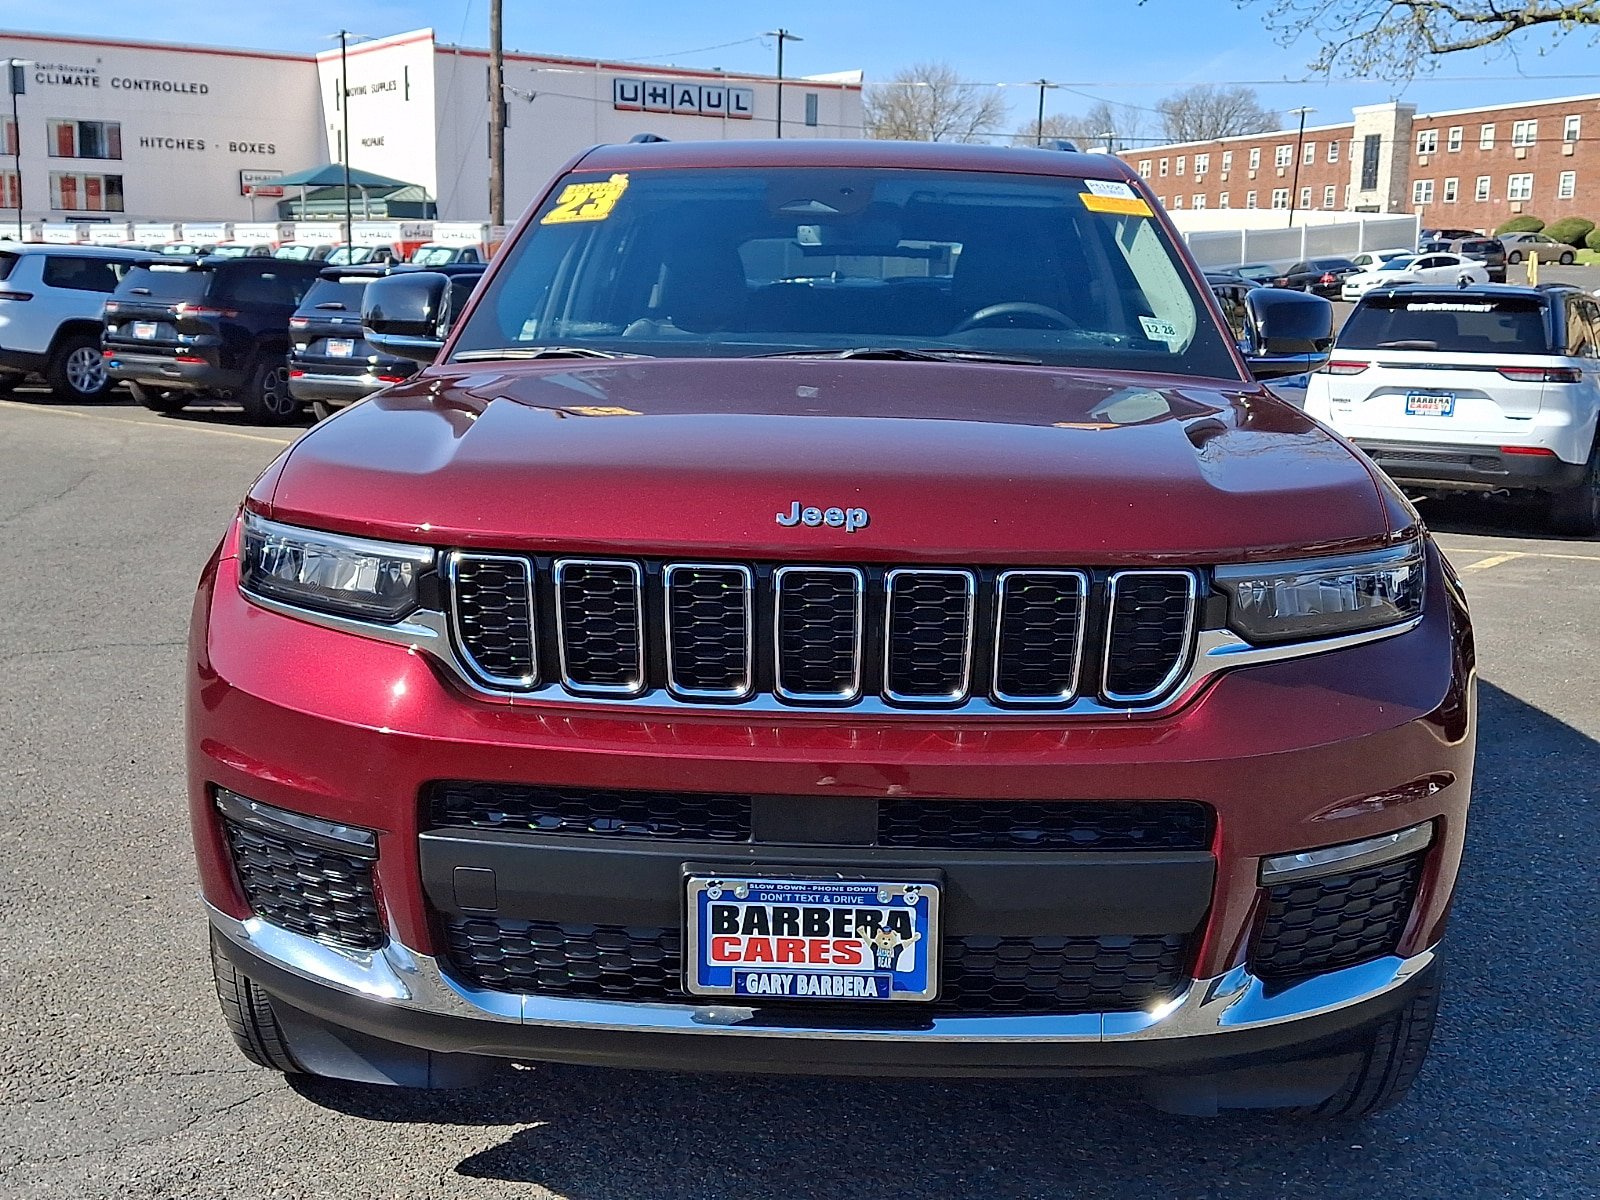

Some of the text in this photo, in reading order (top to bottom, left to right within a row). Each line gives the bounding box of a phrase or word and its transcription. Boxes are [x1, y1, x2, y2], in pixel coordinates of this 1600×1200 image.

[35, 72, 209, 94] CLIMATE CONTROLLED
[140, 136, 276, 154] HITCHES BOXES
[545, 191, 616, 219] 23
[1146, 324, 1176, 336] 12 28
[776, 501, 868, 532] Jeep
[760, 893, 865, 904] DON'T TEXT & DRIVE
[711, 904, 912, 940] BARBERA
[711, 936, 863, 965] CARES
[877, 956, 892, 969] BEAR
[746, 973, 879, 998] GARY BARBERA
